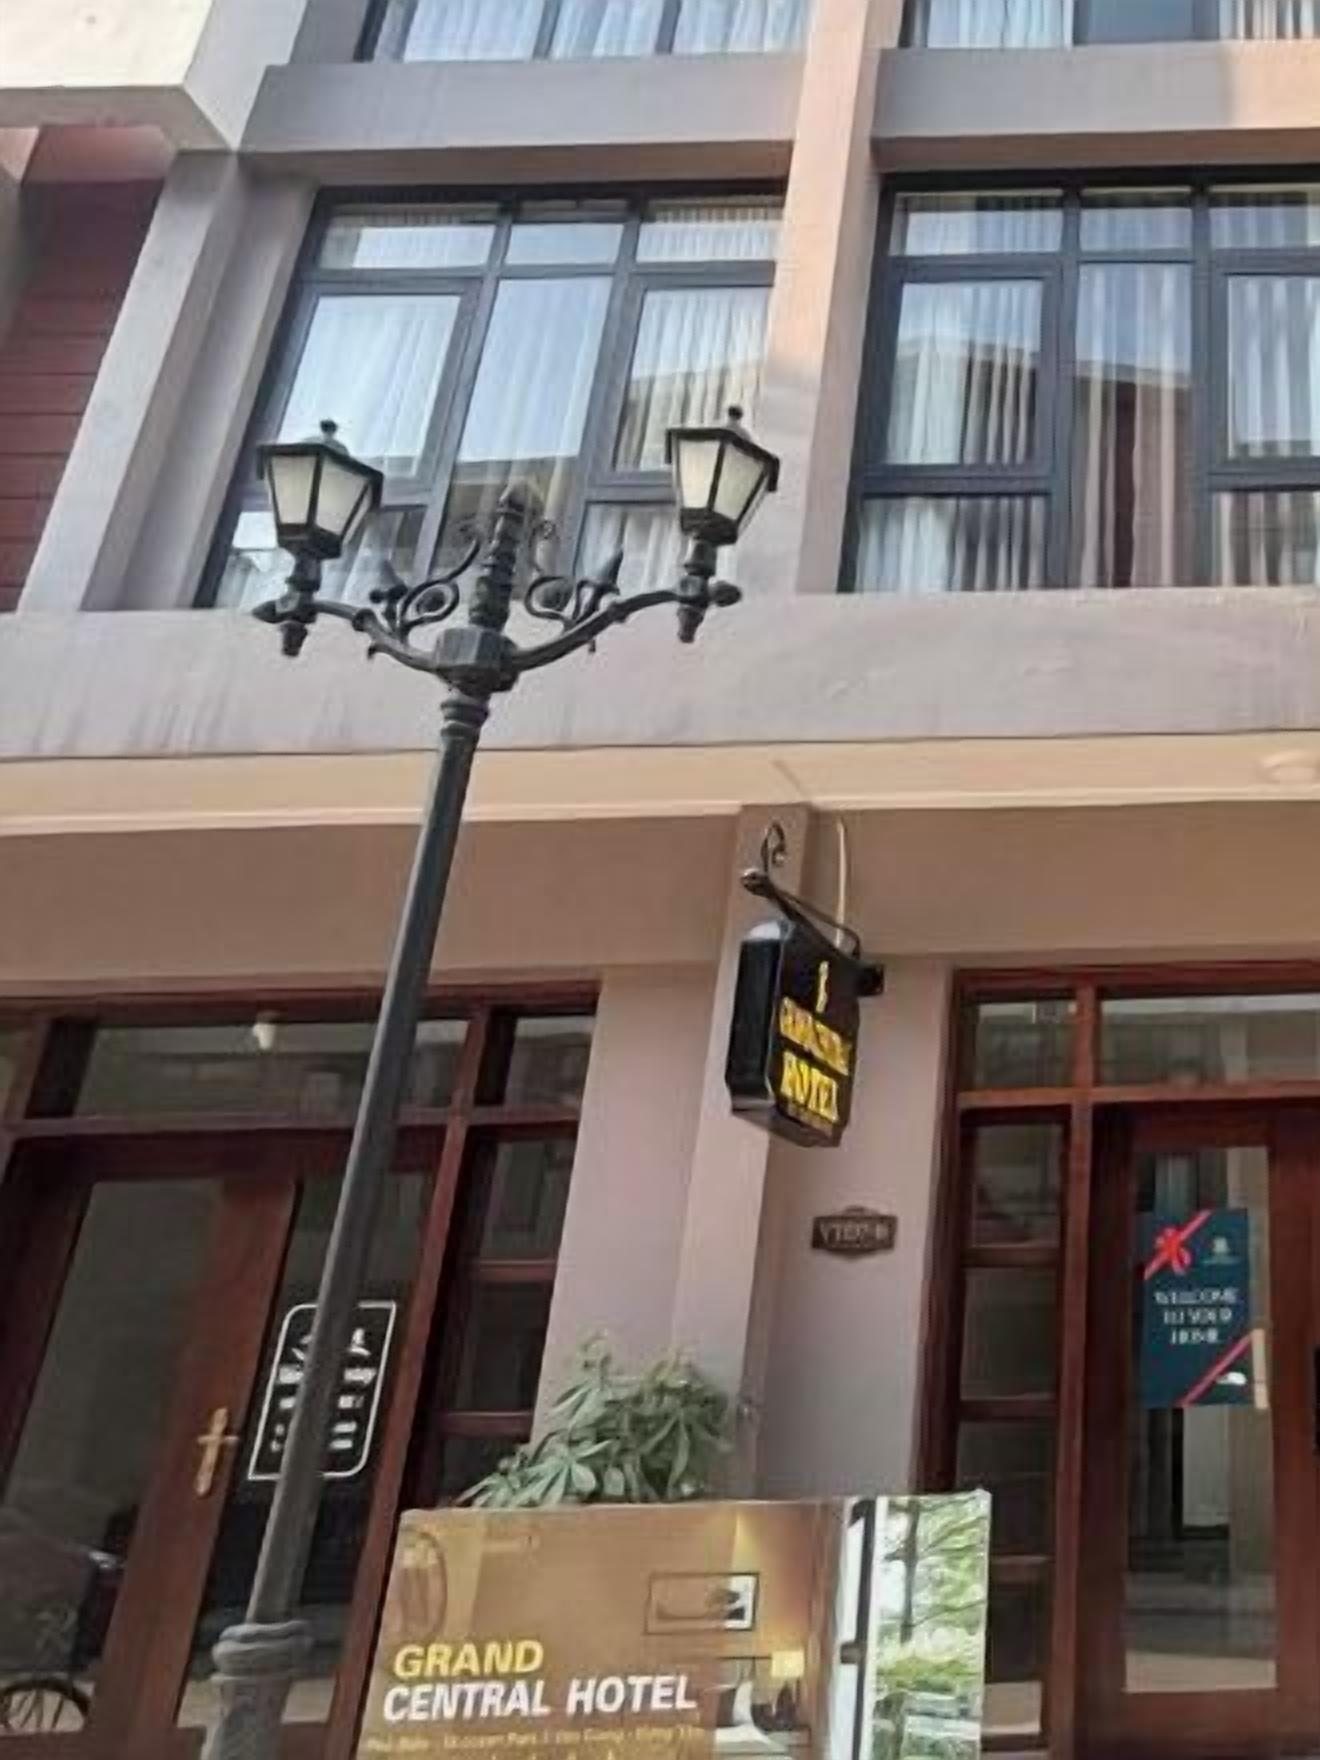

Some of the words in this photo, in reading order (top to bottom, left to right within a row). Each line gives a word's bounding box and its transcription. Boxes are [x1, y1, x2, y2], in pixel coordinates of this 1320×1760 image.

[393, 1639, 545, 1678] GRAND
[383, 1679, 552, 1721] CENTRAL
[566, 1673, 698, 1715] HOTEL
